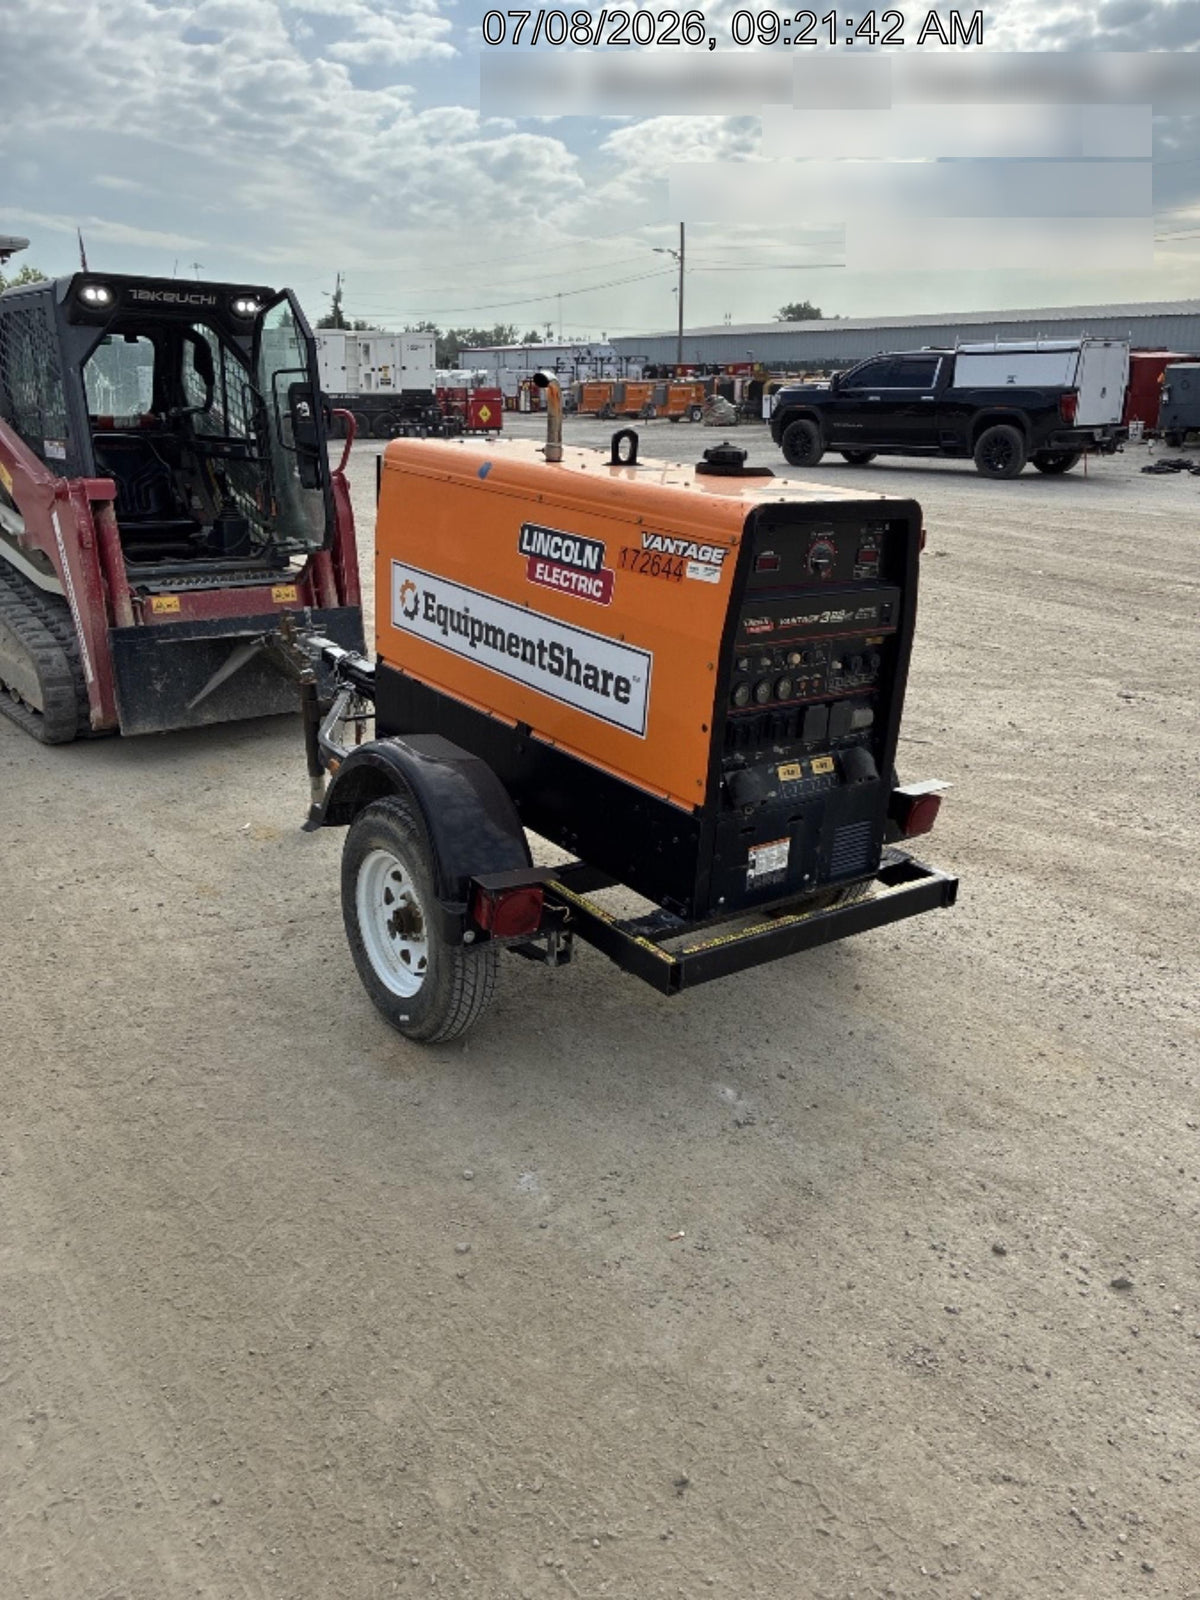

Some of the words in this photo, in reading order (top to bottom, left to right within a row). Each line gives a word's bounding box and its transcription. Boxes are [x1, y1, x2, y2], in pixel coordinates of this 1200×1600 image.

[128, 289, 216, 305] TAKEUCHI
[522, 529, 600, 570] LINCOLN
[621, 547, 684, 582] 172644
[641, 532, 726, 565] VANTAGE
[535, 563, 603, 598] ELECTRIC
[422, 590, 631, 705] EquipmentShare
